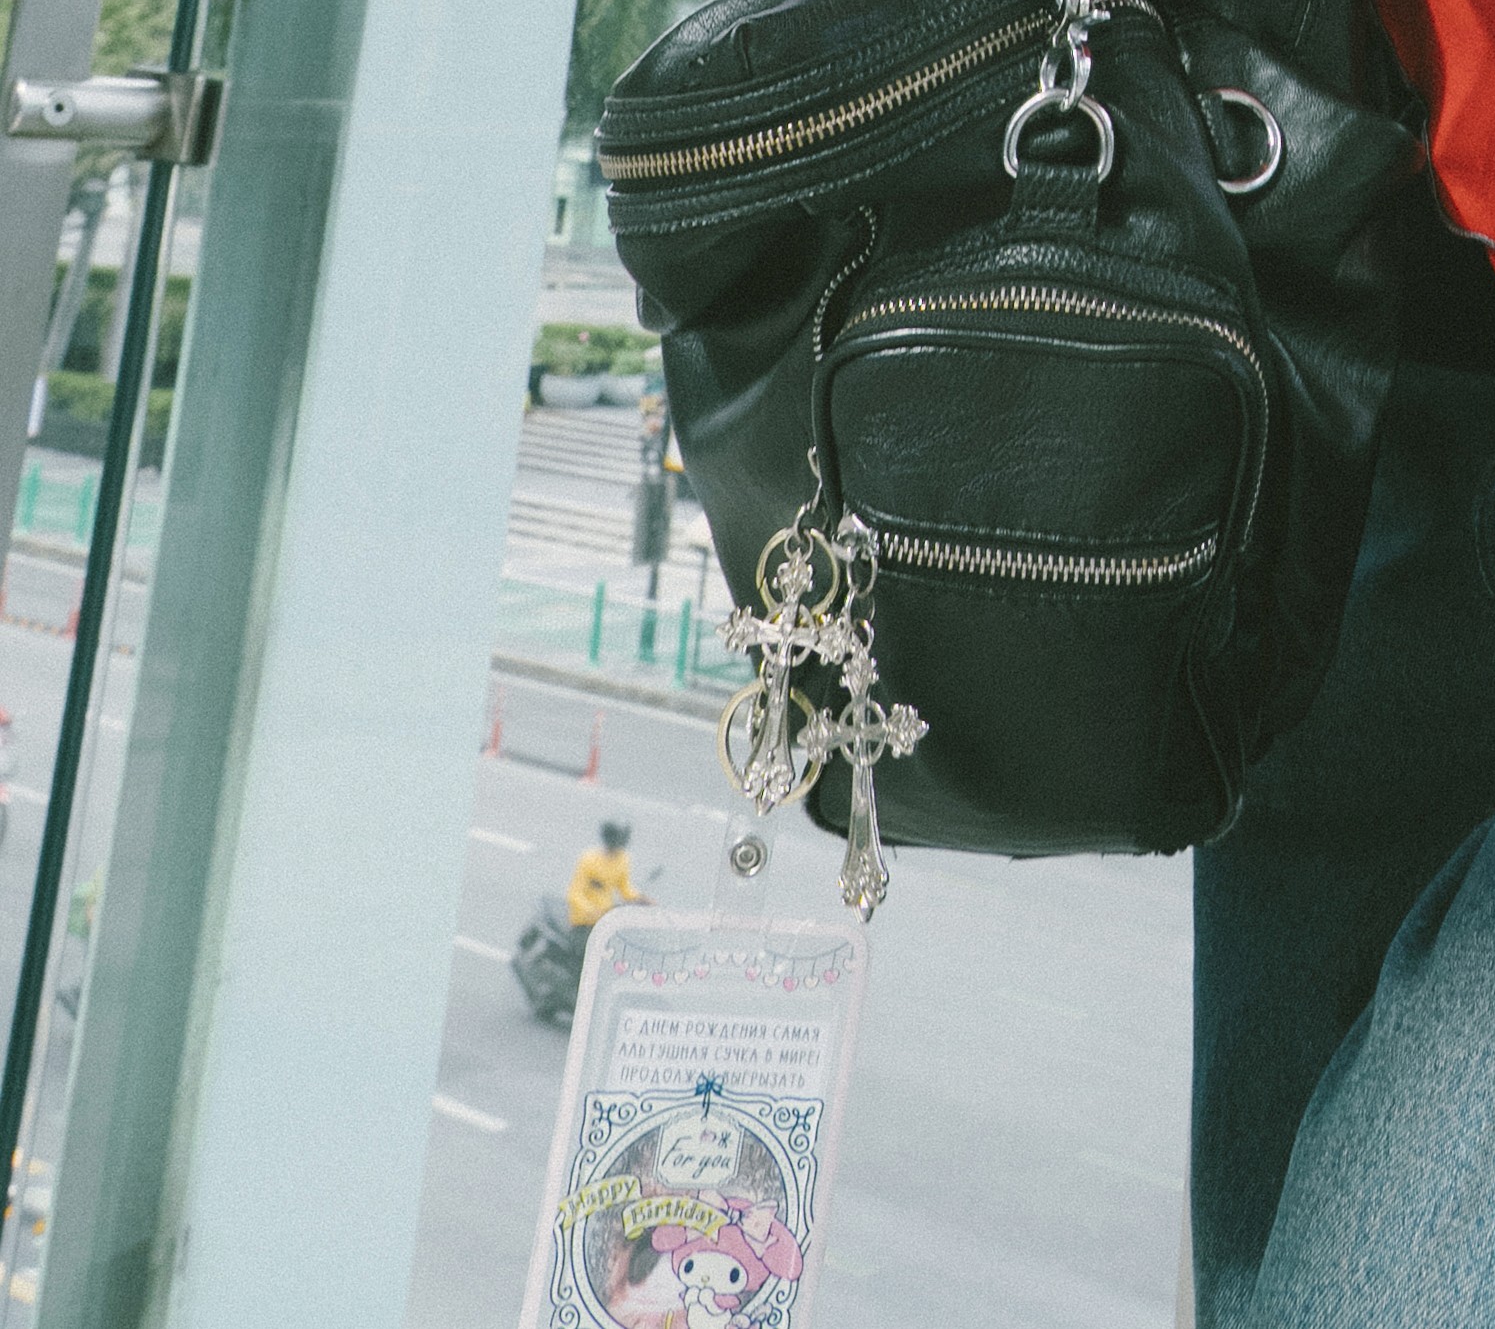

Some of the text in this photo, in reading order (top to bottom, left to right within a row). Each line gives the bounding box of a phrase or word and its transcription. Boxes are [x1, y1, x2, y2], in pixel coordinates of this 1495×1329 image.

[685, 1020, 767, 1040] РОЖДЕНИЯ
[772, 1025, 820, 1042] САМАЯ
[662, 1136, 732, 1180] For you
[568, 1179, 637, 1212] Happy
[631, 1198, 719, 1232] Birthday
